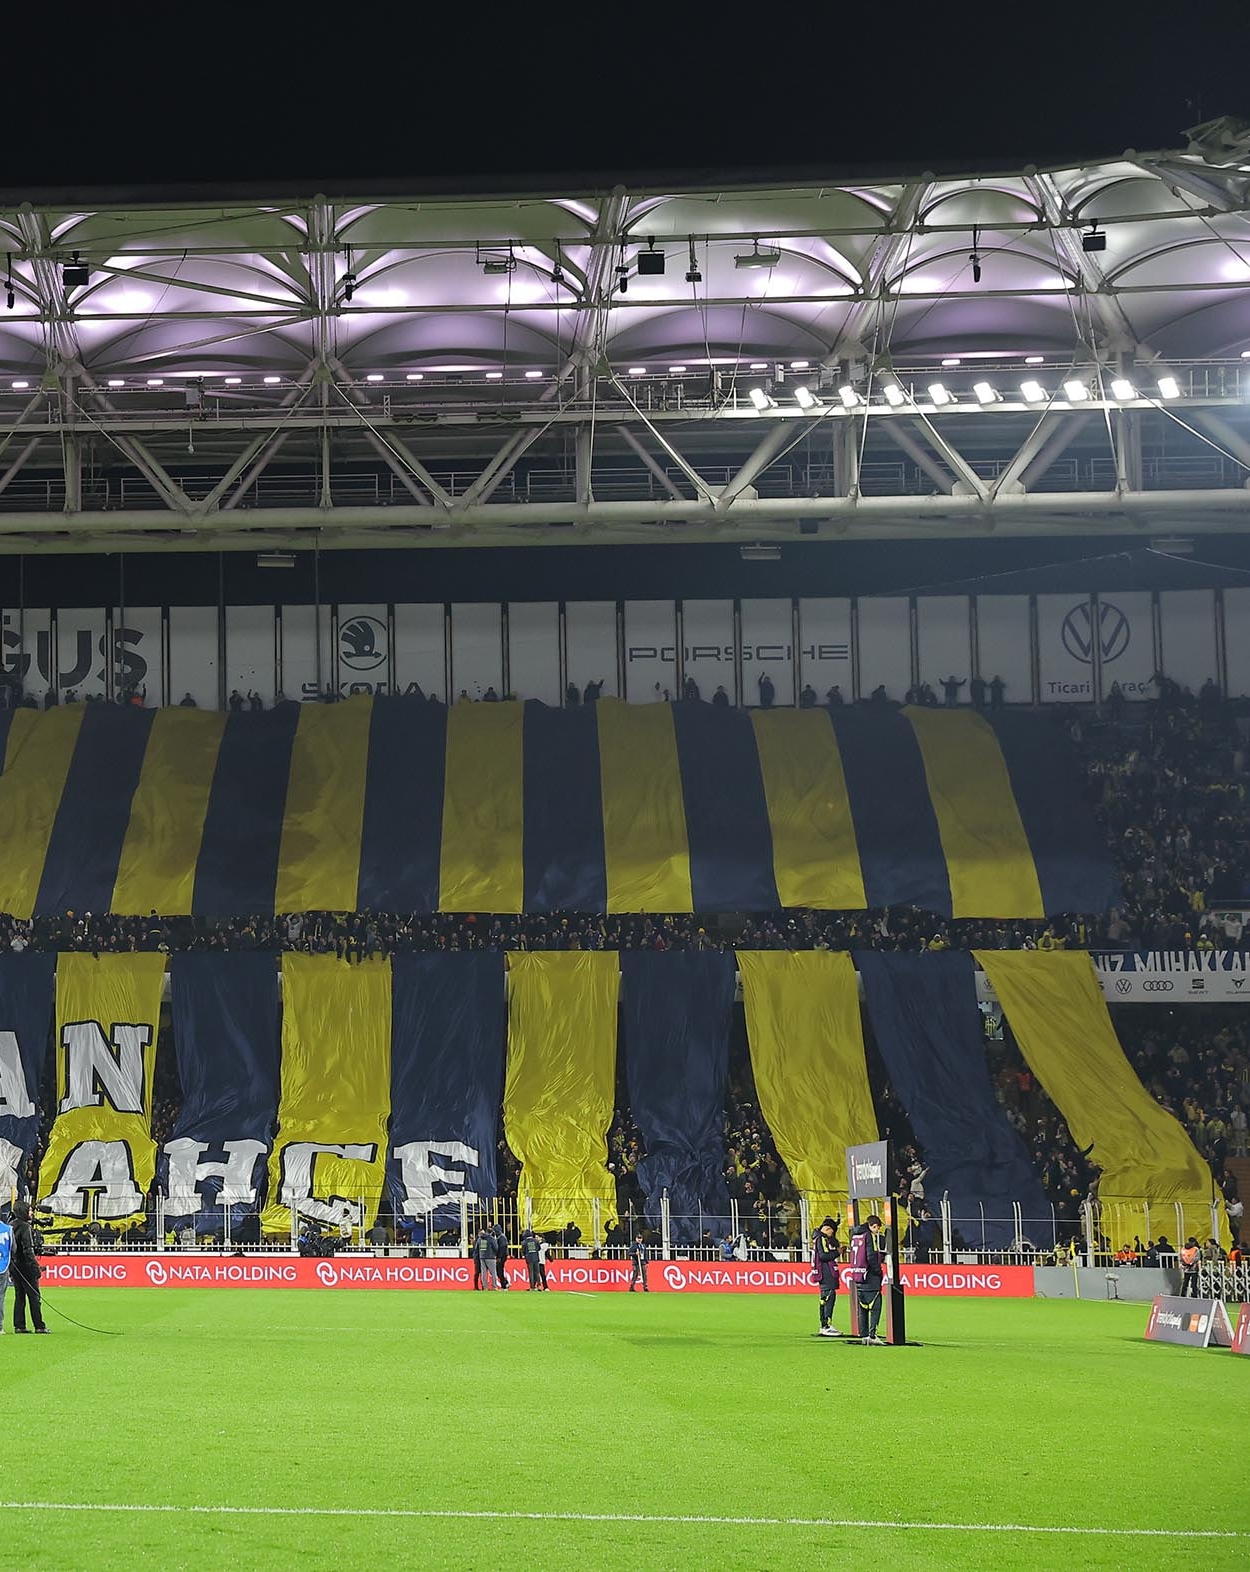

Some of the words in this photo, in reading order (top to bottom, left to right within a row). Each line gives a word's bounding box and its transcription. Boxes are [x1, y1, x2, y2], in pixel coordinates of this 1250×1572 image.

[629, 644, 849, 662] PORSCHE
[1048, 681, 1090, 694] Ticari
[169, 1265, 212, 1280] NATA
[341, 1267, 384, 1281] NATA
[688, 1270, 733, 1285] NATA
